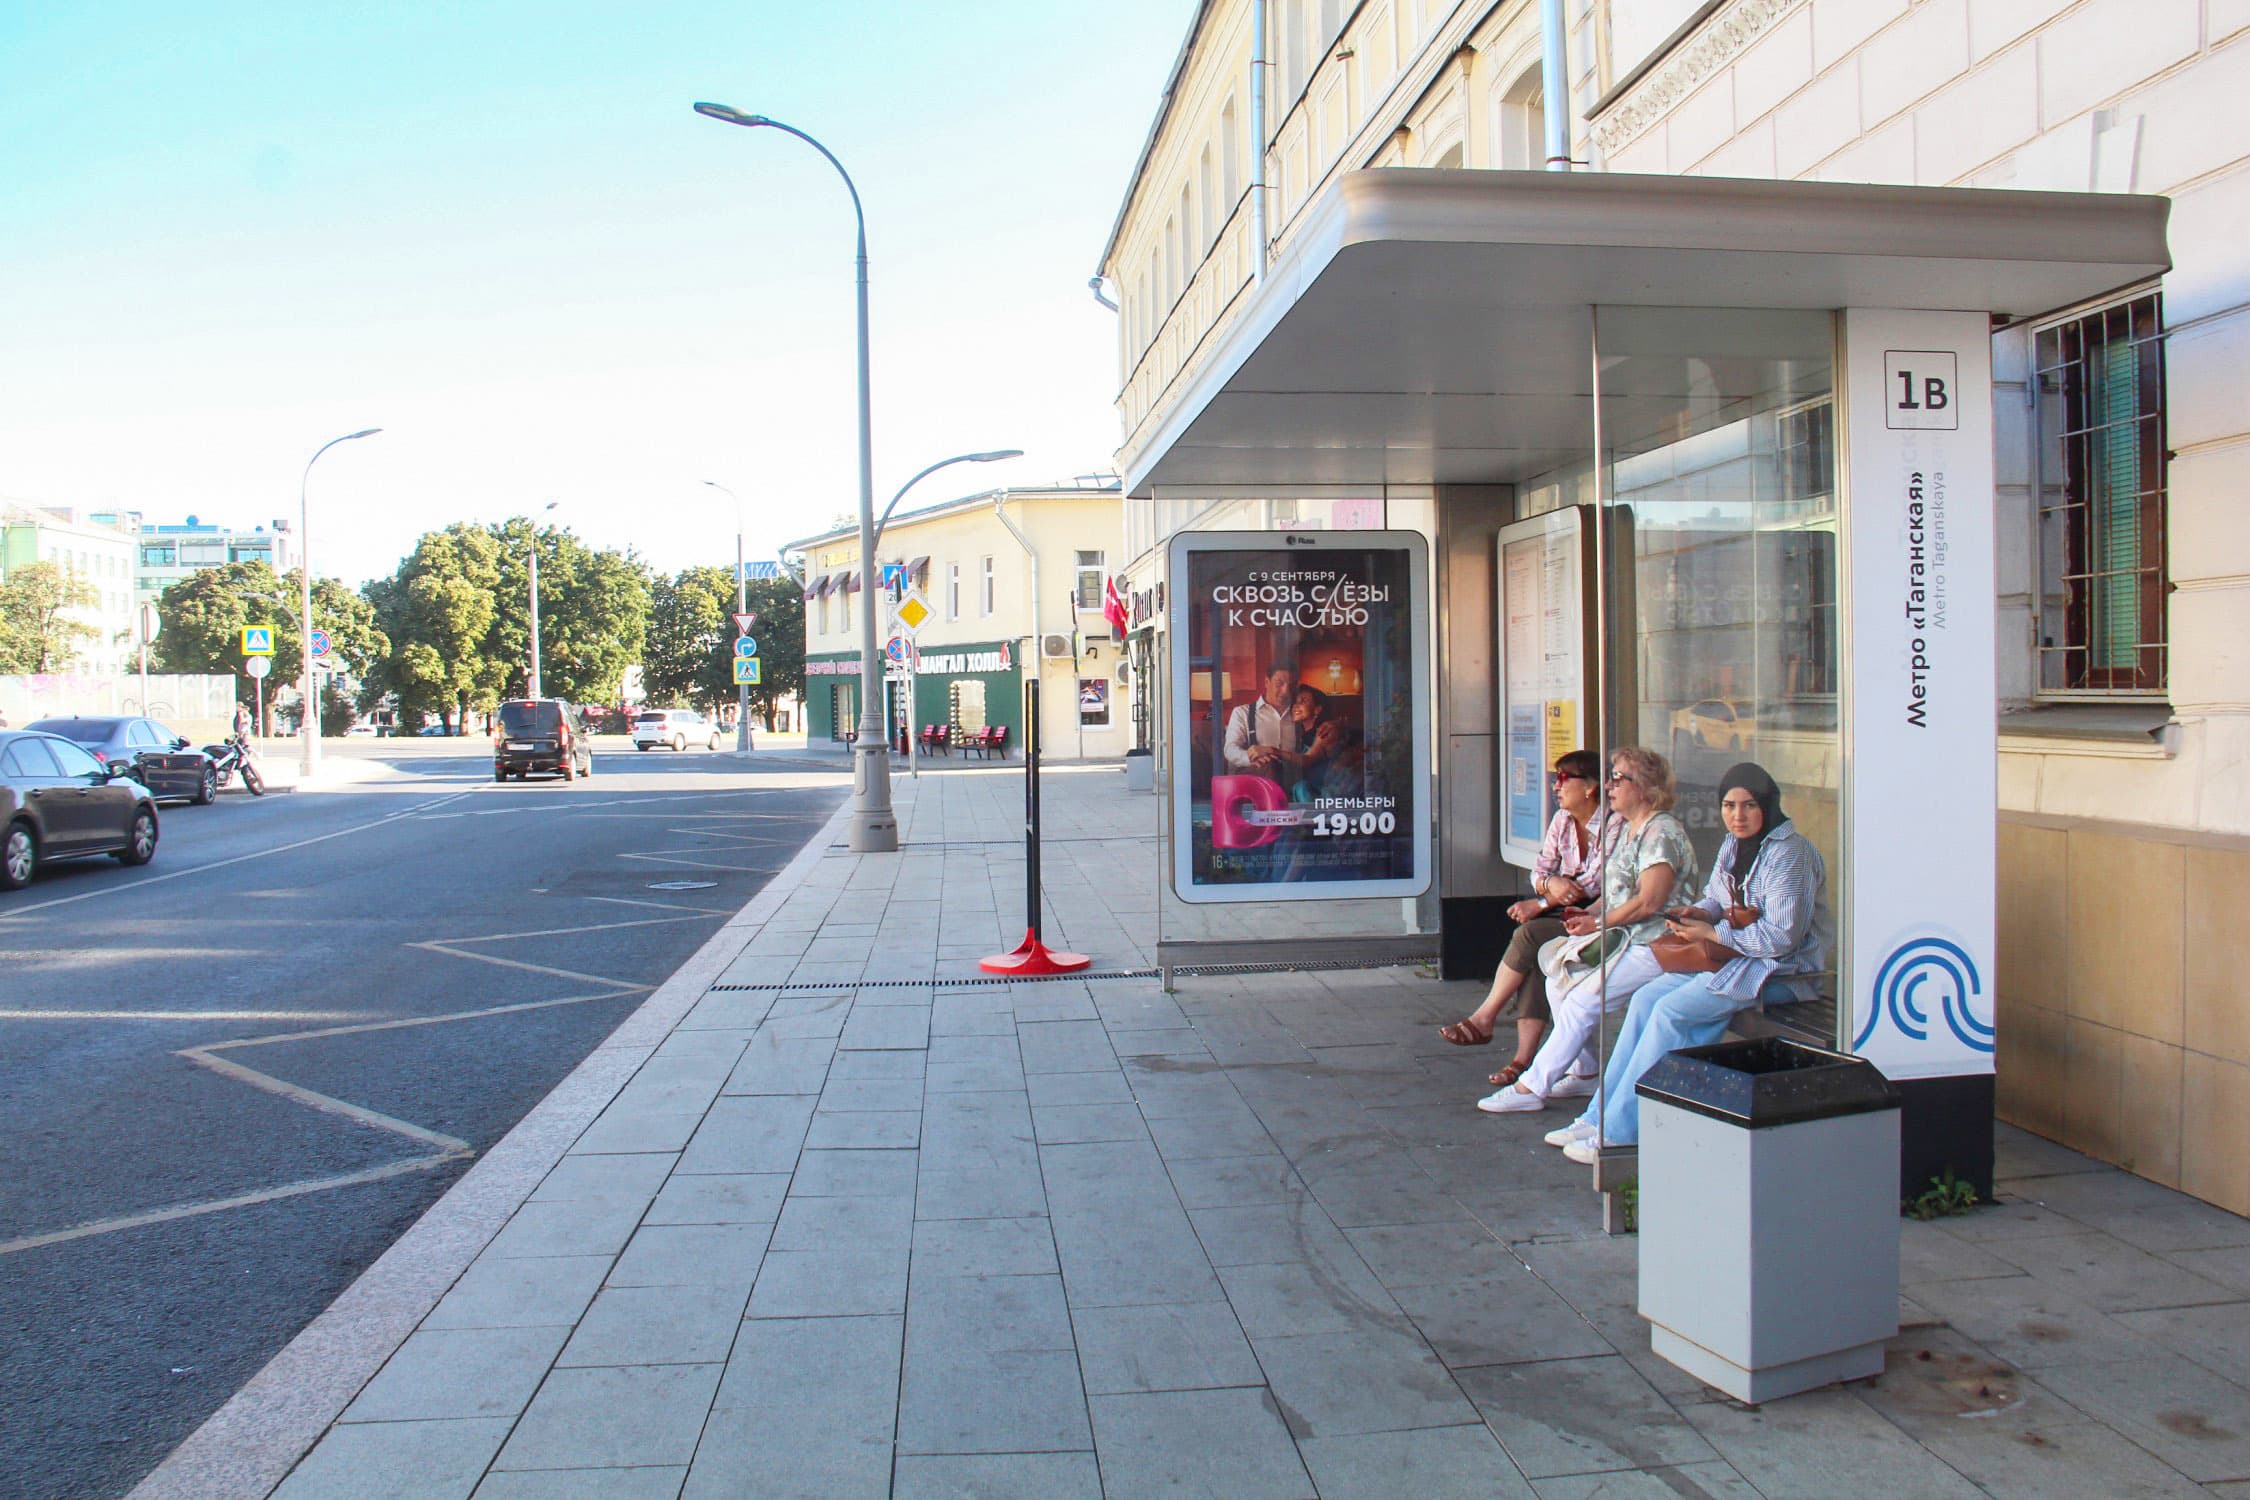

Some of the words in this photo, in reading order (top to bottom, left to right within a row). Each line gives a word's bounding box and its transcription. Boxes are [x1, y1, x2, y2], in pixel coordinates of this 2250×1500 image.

[1932, 471, 1949, 571] Taganskaya
[1905, 471, 1926, 630] «Таганская»
[1213, 585, 1305, 604] СКВОЗЬ
[1311, 574, 1389, 610] СЛЁЗЫ
[1249, 572, 1257, 582] С
[1261, 572, 1268, 582] 9
[1272, 571, 1336, 582] СЕНТЯБРЯ
[1229, 609, 1244, 627] К
[1250, 602, 1369, 629] СЧАСТЬЮ
[1933, 573, 1946, 629] Metro
[967, 651, 1000, 673] ХОЛЛ
[1907, 637, 1930, 728] Метро
[1314, 796, 1395, 810] ПРЕМЬЕРЫ
[1312, 811, 1396, 836] 19:00
